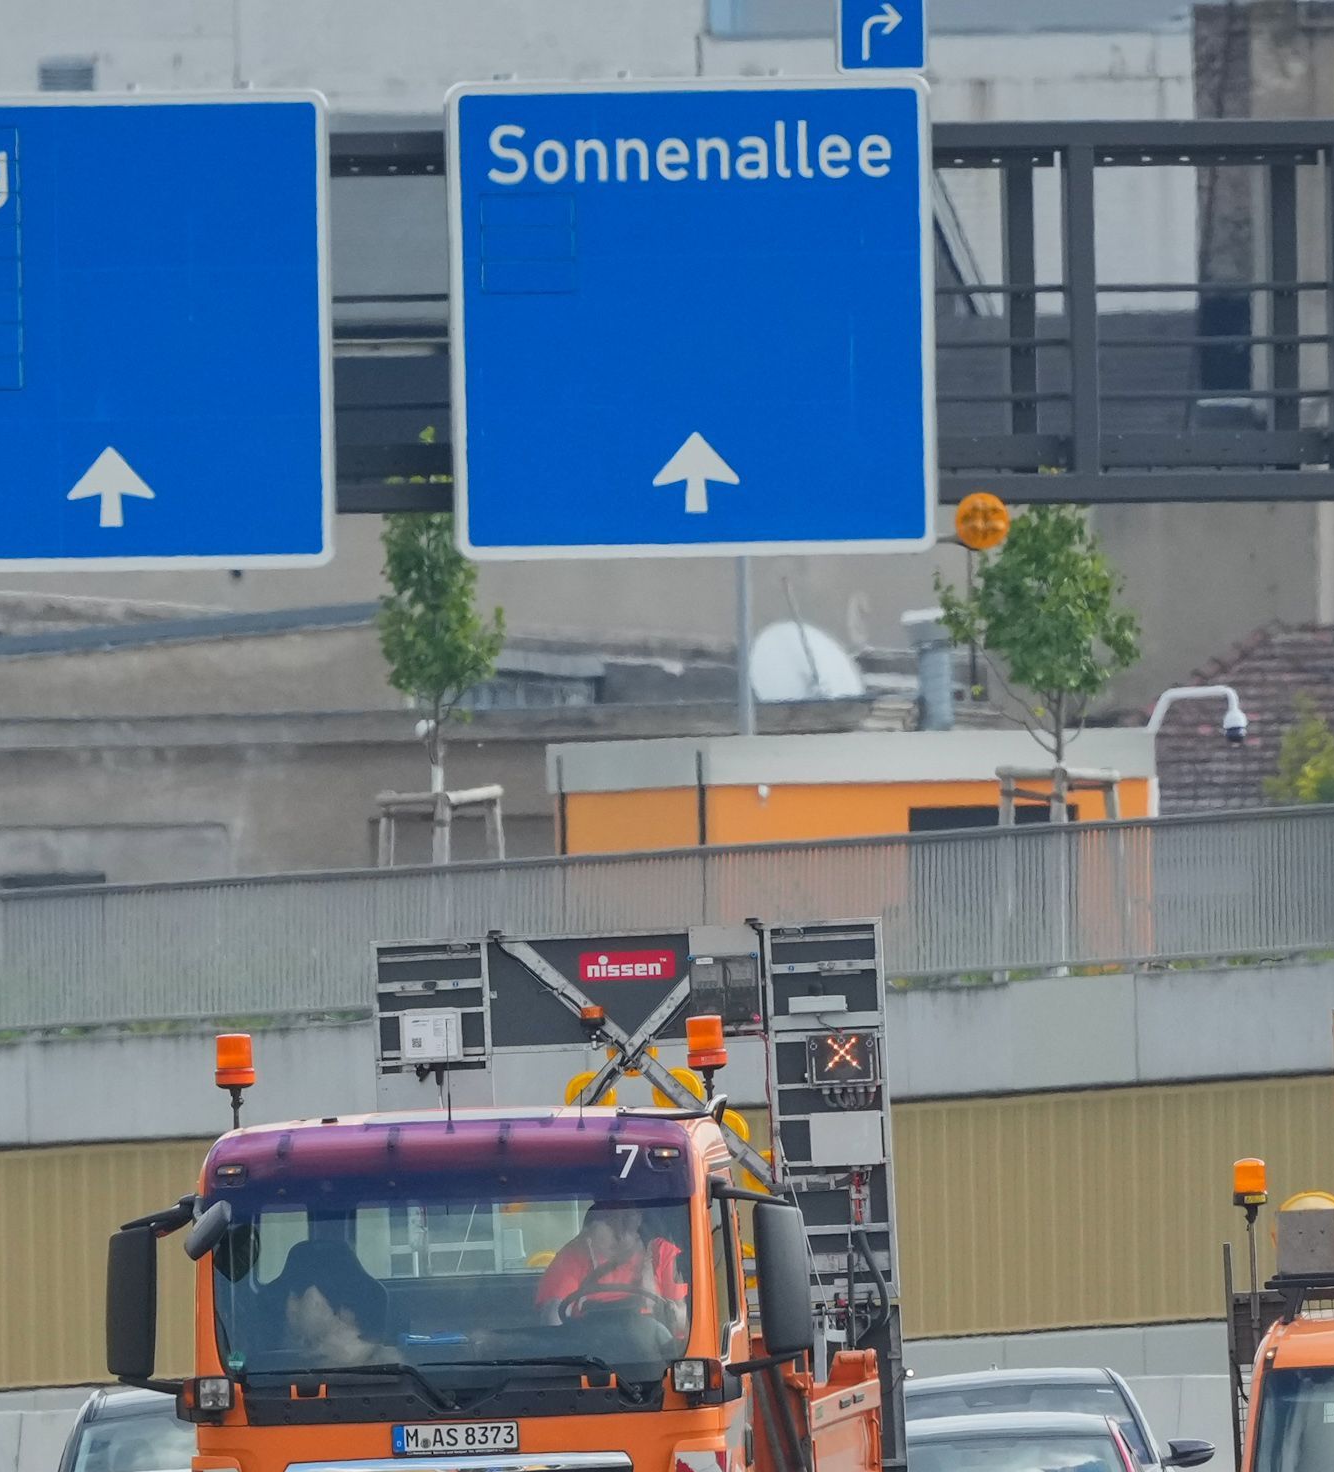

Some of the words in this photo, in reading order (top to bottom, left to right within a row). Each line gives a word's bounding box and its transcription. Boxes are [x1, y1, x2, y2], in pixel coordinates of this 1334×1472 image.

[489, 120, 893, 184] Sonnenallee
[586, 955, 662, 978] nissen
[615, 1144, 639, 1179] 7
[405, 1428, 419, 1448] M
[432, 1428, 458, 1447] AS
[464, 1425, 515, 1446] 8373
